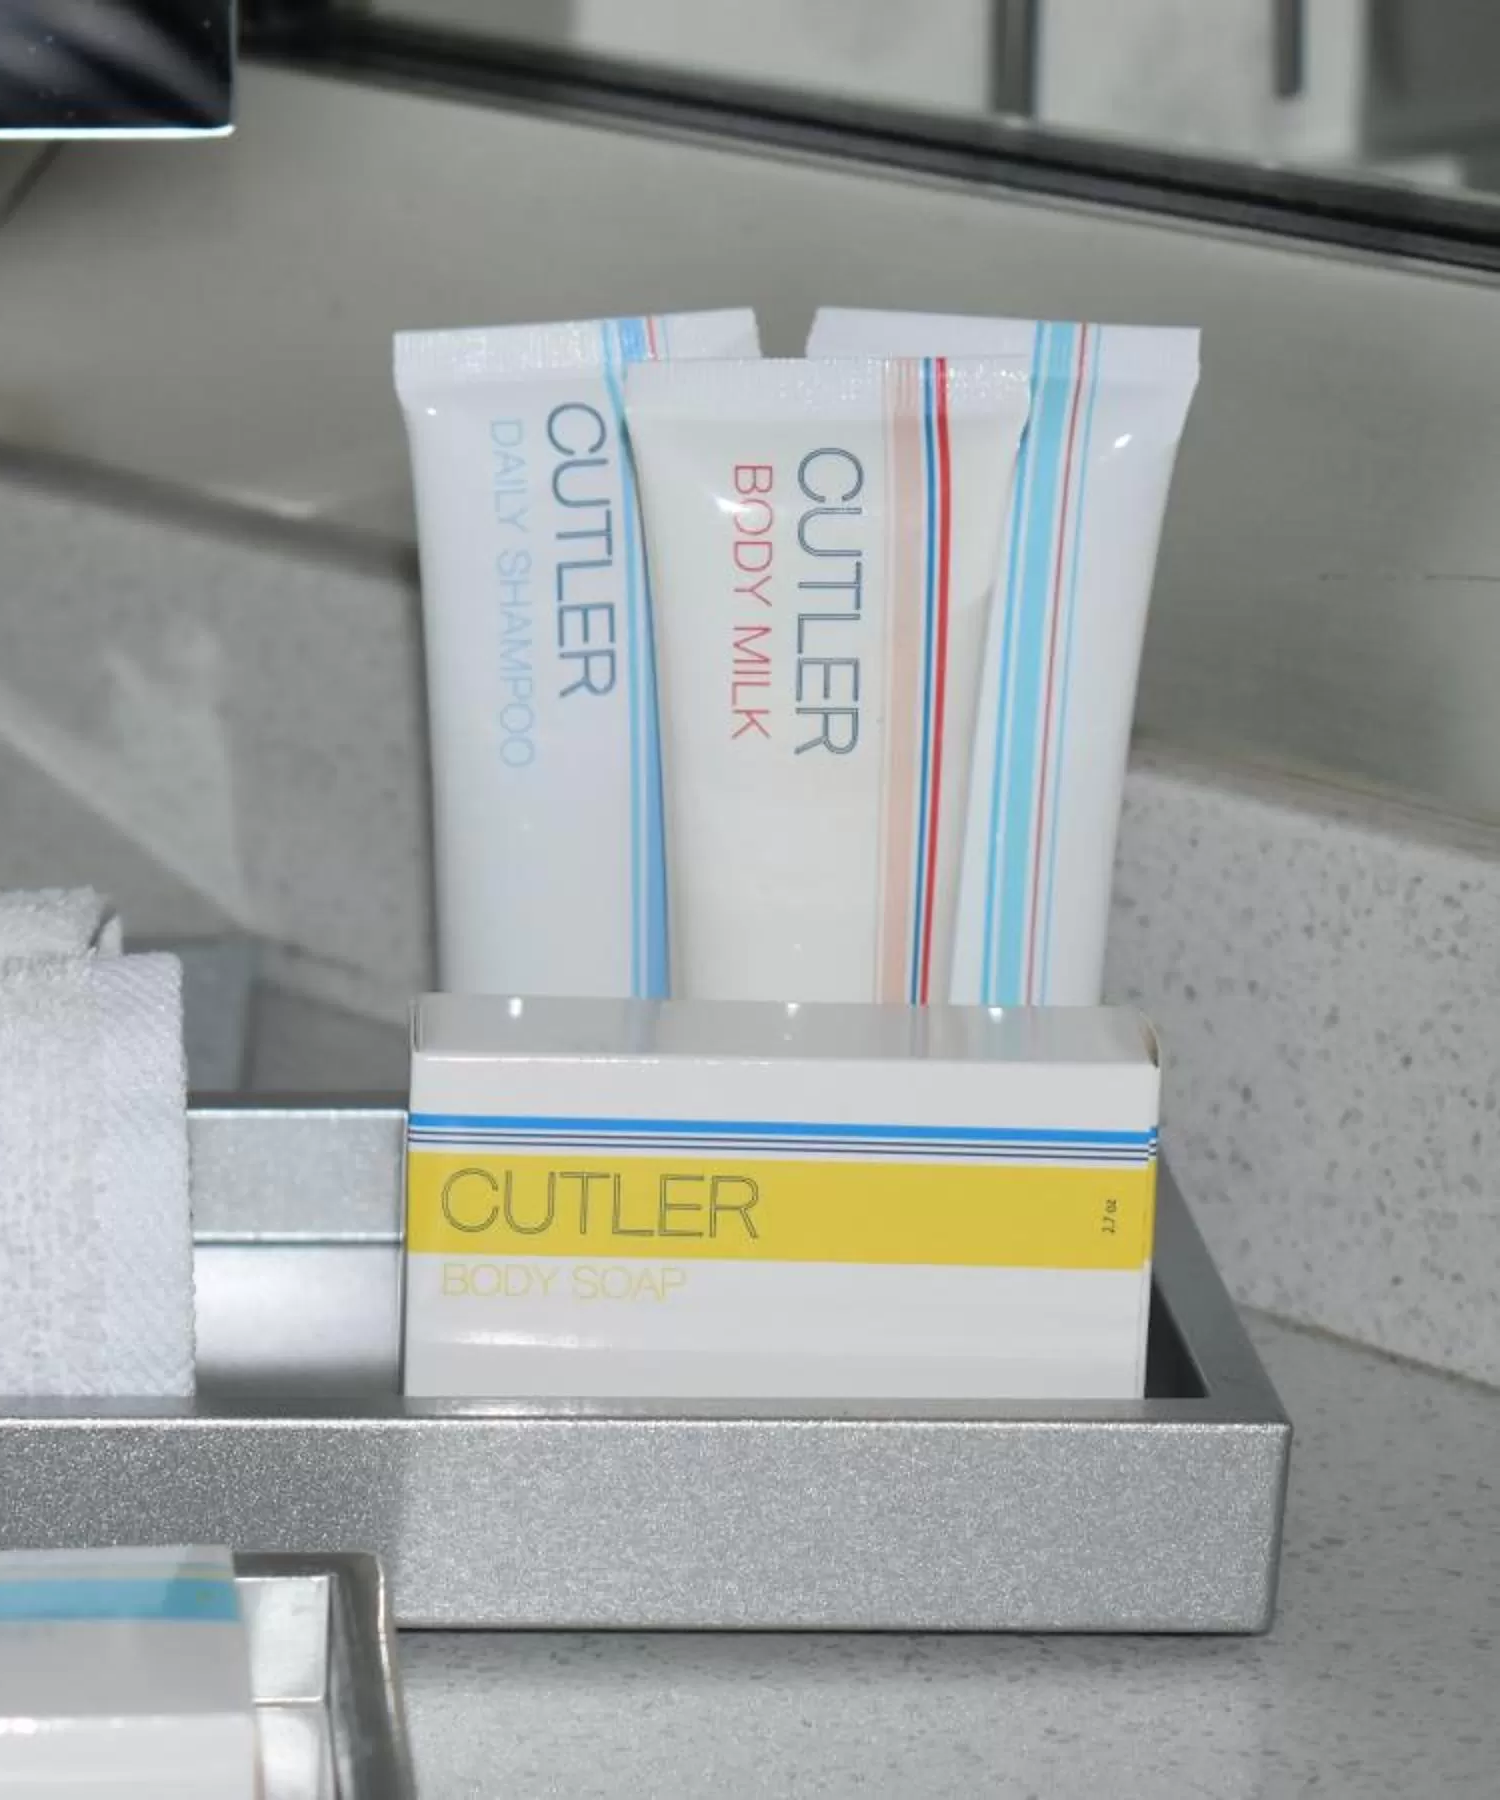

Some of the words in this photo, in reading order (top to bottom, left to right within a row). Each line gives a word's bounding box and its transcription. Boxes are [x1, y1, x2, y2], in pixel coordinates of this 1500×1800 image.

[490, 418, 529, 534] DAILY
[733, 465, 773, 607] BODY
[546, 402, 616, 699] CUTLER
[794, 447, 864, 756] CUTLER
[496, 549, 535, 768] SHAMPOO
[731, 626, 772, 740] MILK
[441, 1167, 759, 1239] CUTLER
[441, 1262, 560, 1297] BODY
[570, 1264, 687, 1301] SOAP
